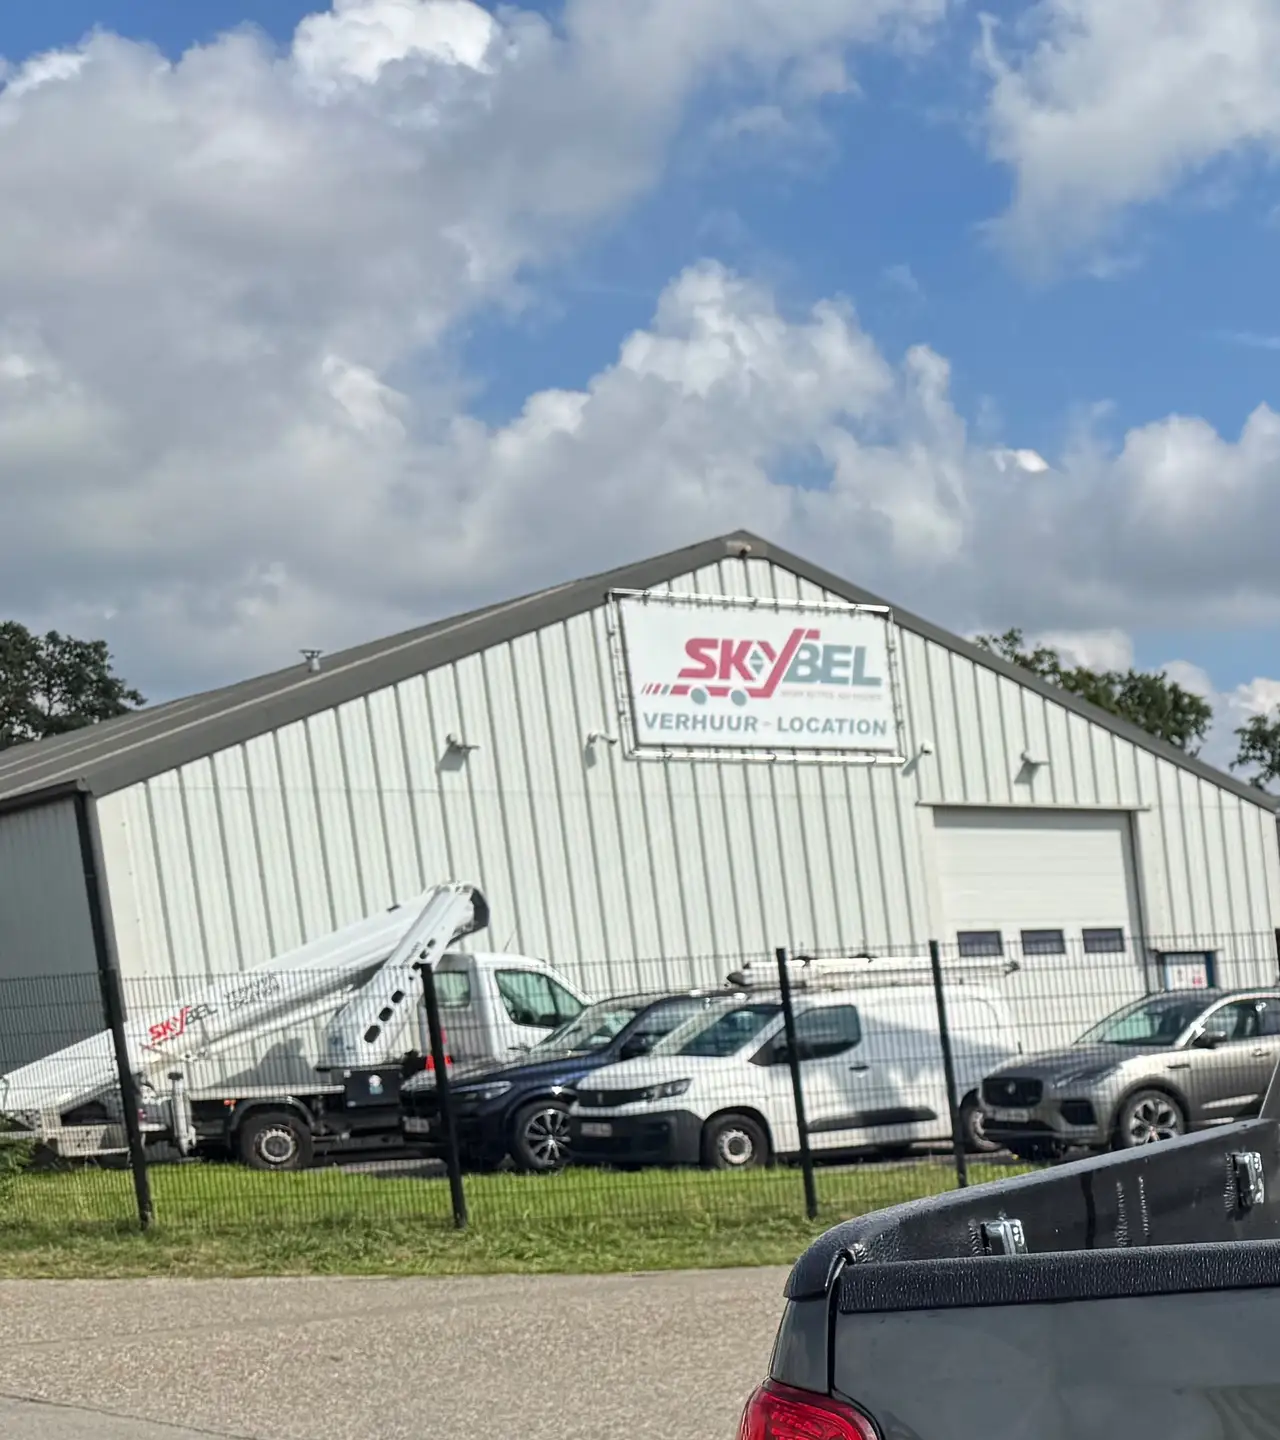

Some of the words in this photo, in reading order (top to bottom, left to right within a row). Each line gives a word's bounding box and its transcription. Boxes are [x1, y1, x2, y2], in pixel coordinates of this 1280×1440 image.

[677, 628, 882, 698] SKYBEL
[643, 711, 758, 732] VERHUUR
[777, 716, 887, 736] LOCATION
